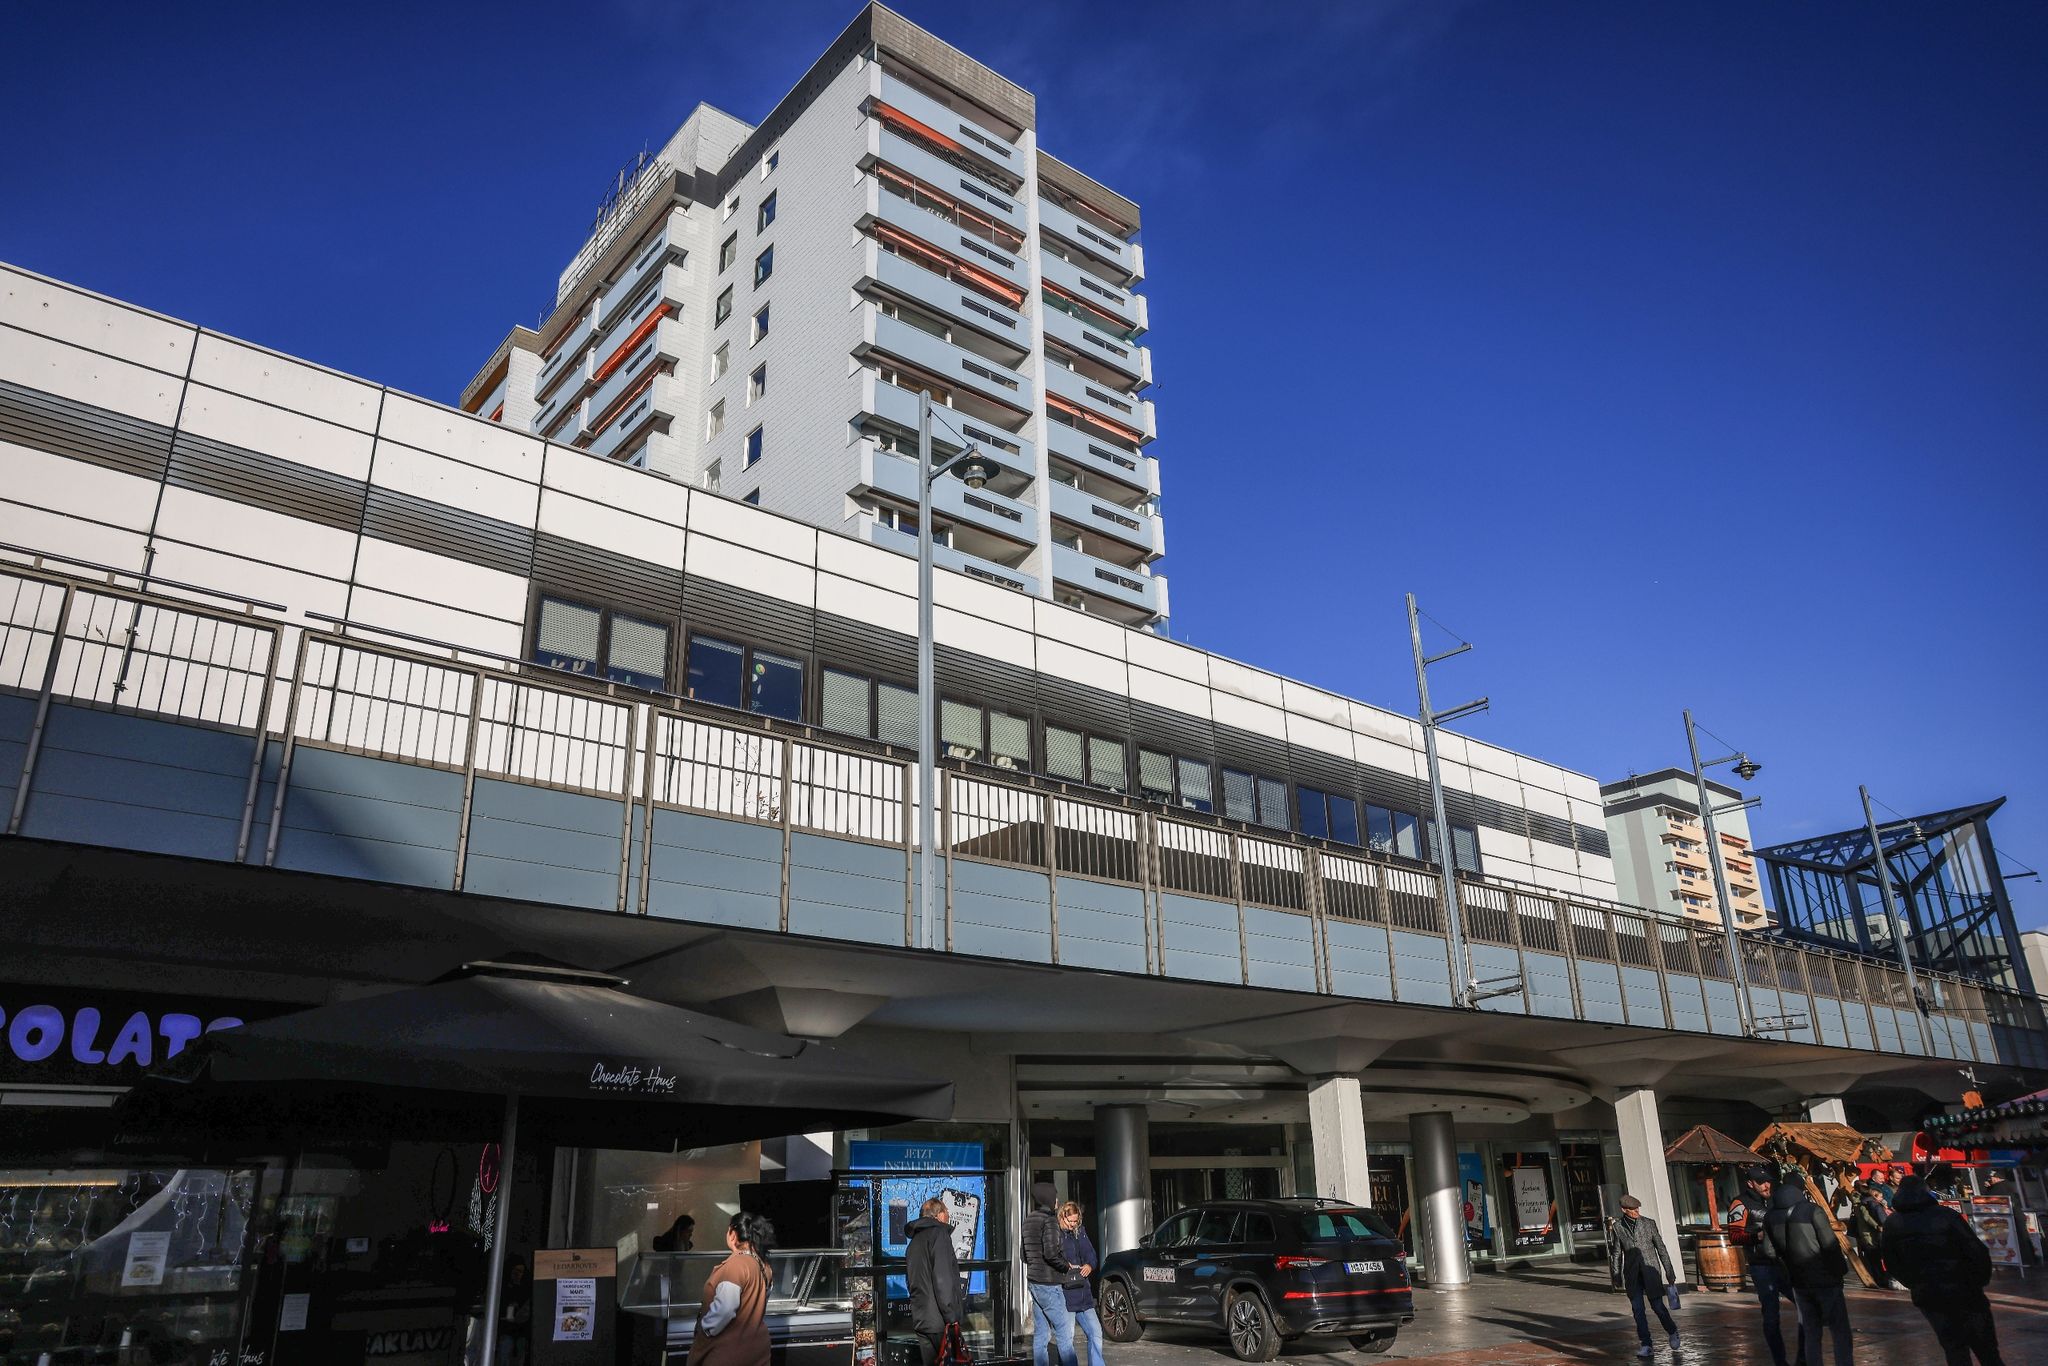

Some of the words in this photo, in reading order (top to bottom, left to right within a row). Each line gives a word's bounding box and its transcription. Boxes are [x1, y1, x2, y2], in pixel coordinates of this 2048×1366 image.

[0, 1003, 245, 1067] OLAT
[590, 1062, 641, 1086] Chocolate
[643, 1066, 676, 1092] Haus
[904, 1148, 934, 1159] JETZT
[365, 1327, 452, 1354] AKLAV
